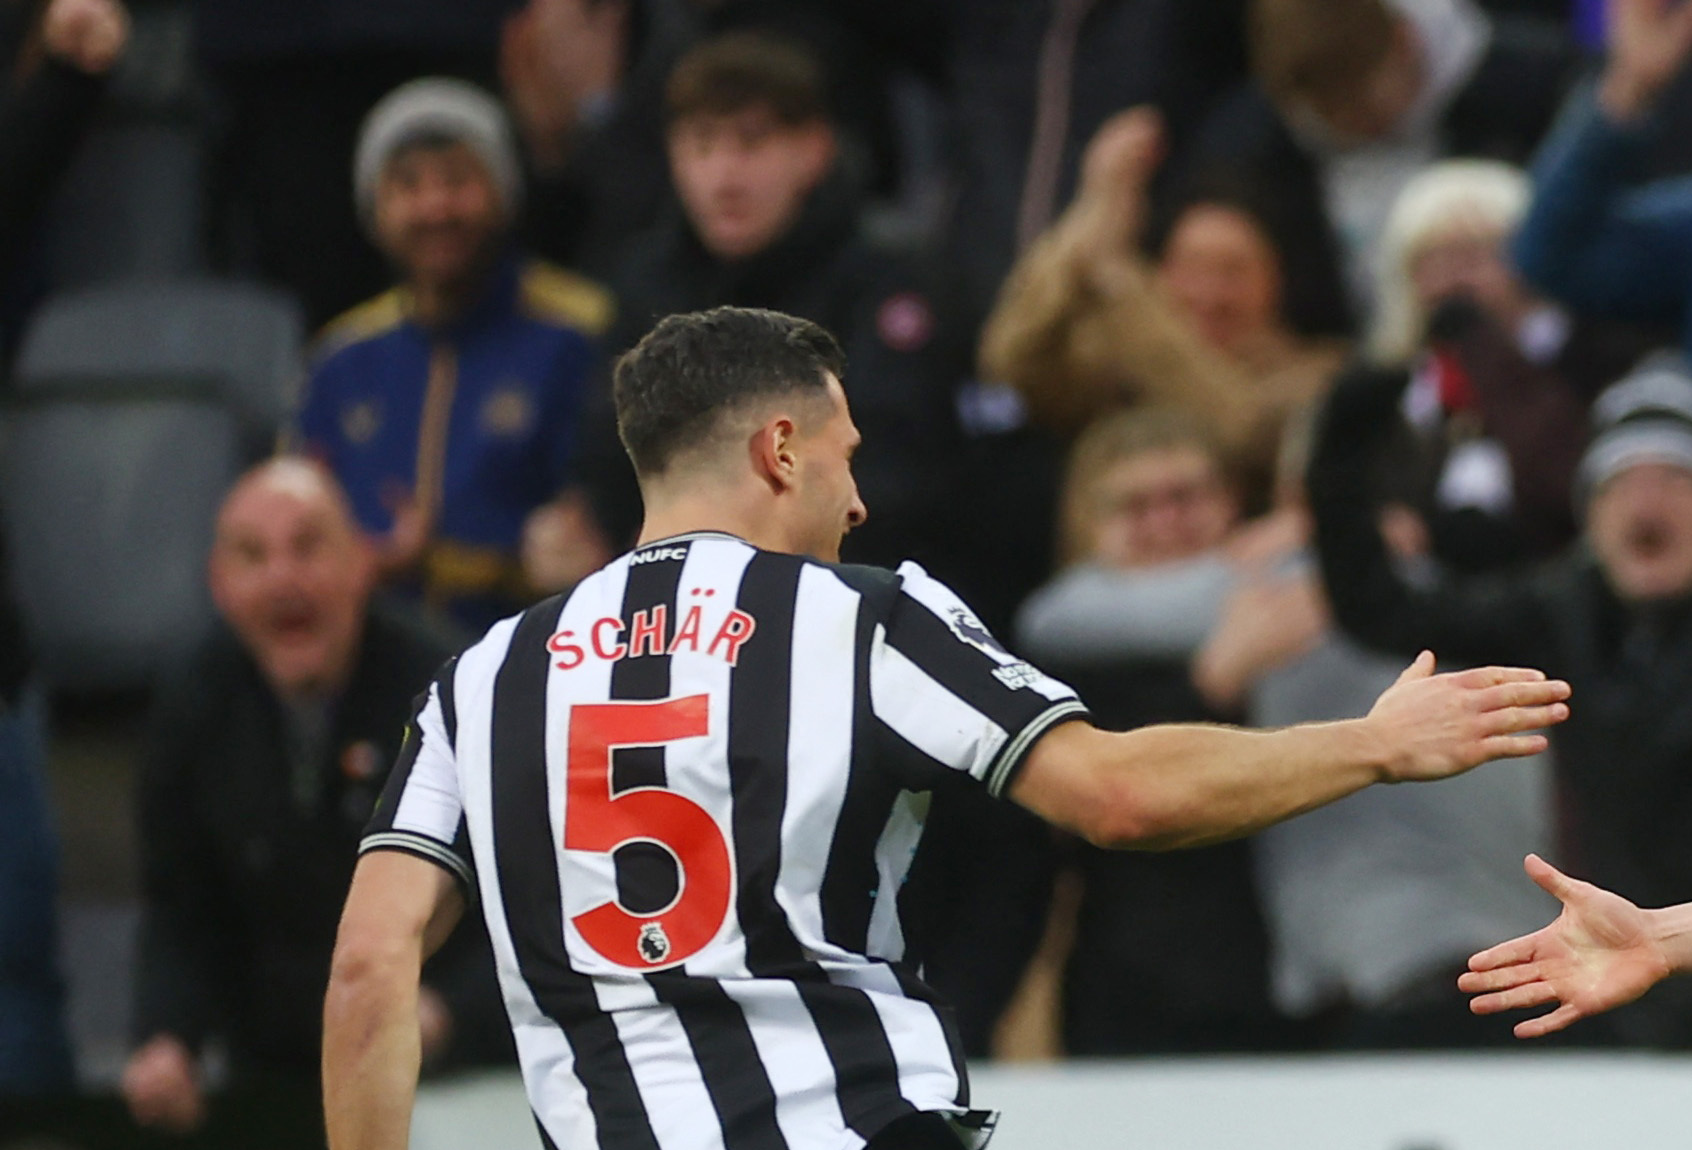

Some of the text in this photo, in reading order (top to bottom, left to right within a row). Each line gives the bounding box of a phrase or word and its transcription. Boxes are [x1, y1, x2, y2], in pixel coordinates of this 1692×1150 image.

[629, 547, 687, 566] NUFC
[547, 587, 756, 671] SCHÄR
[563, 693, 735, 969] 5
